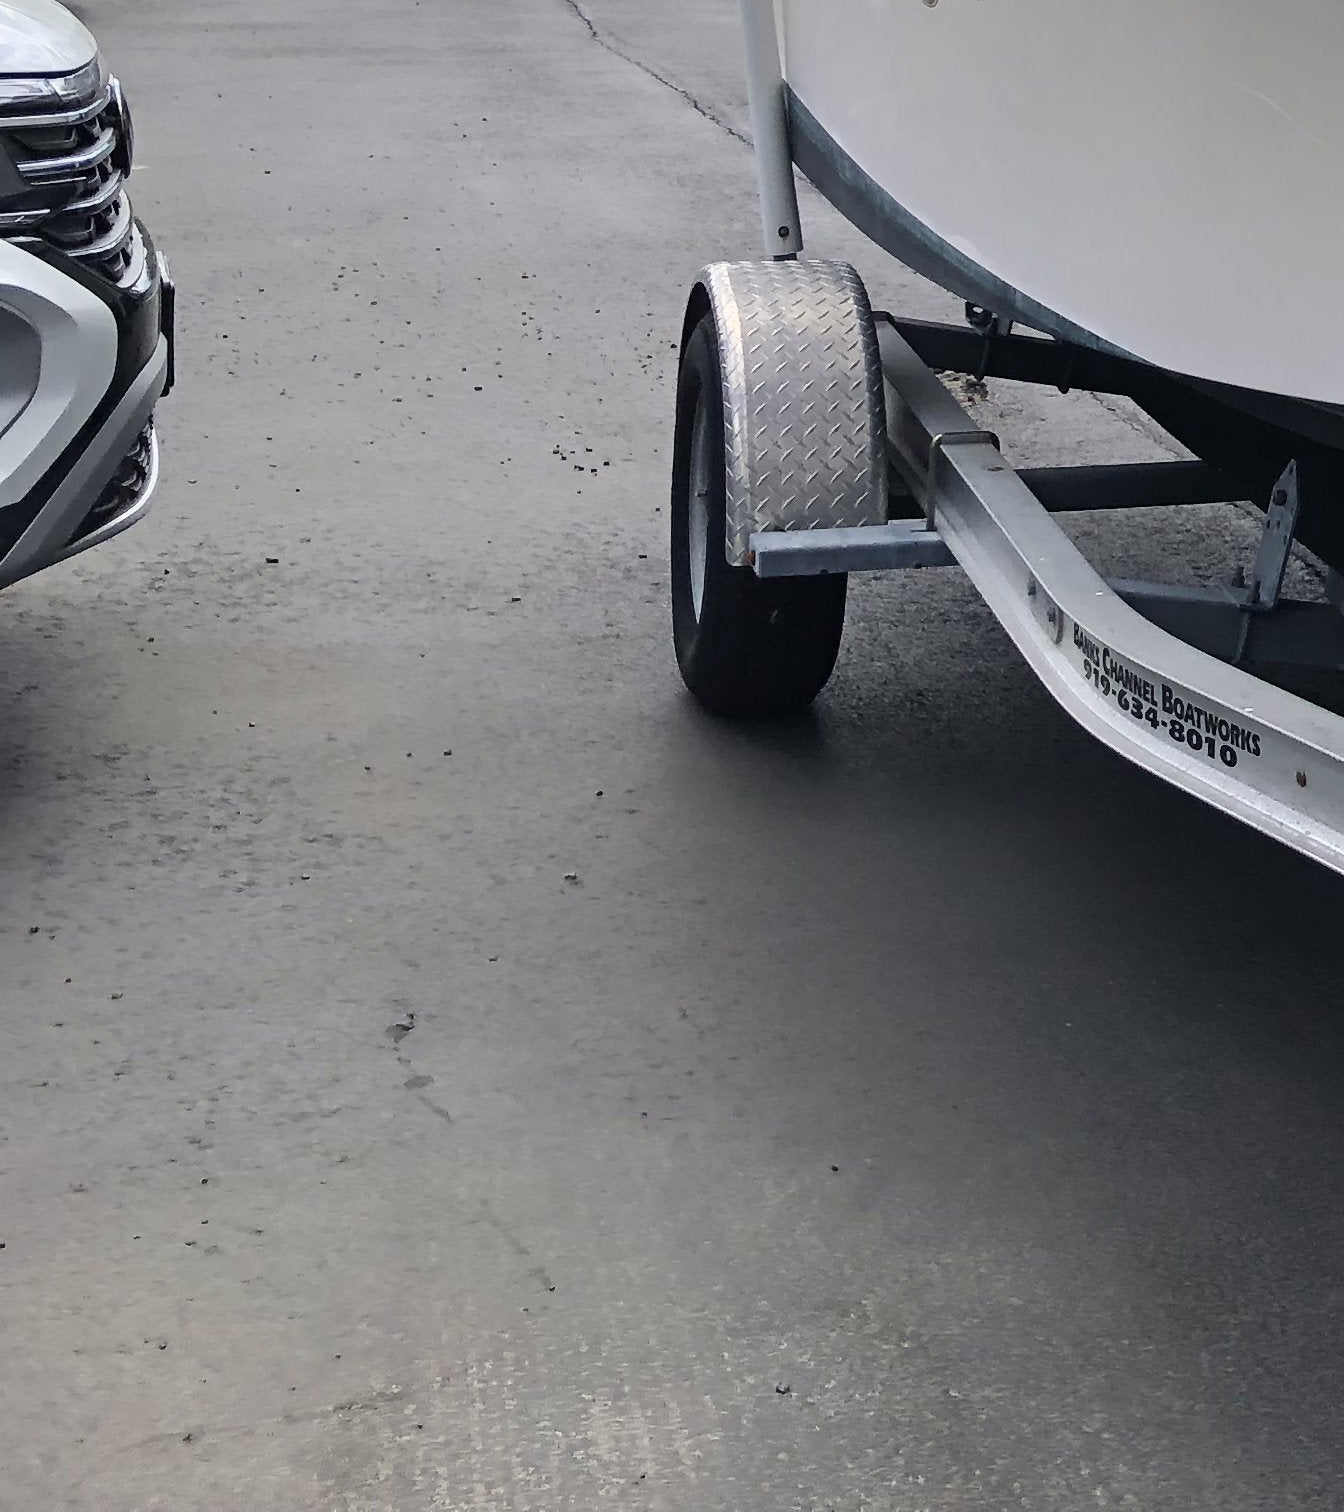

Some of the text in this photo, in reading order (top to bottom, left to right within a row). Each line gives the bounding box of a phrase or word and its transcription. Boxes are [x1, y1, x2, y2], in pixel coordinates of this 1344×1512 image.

[1083, 658, 1238, 768] 919-634-8010
[1102, 647, 1158, 708] CHANNEL
[1161, 683, 1261, 757] BOATWORKS
